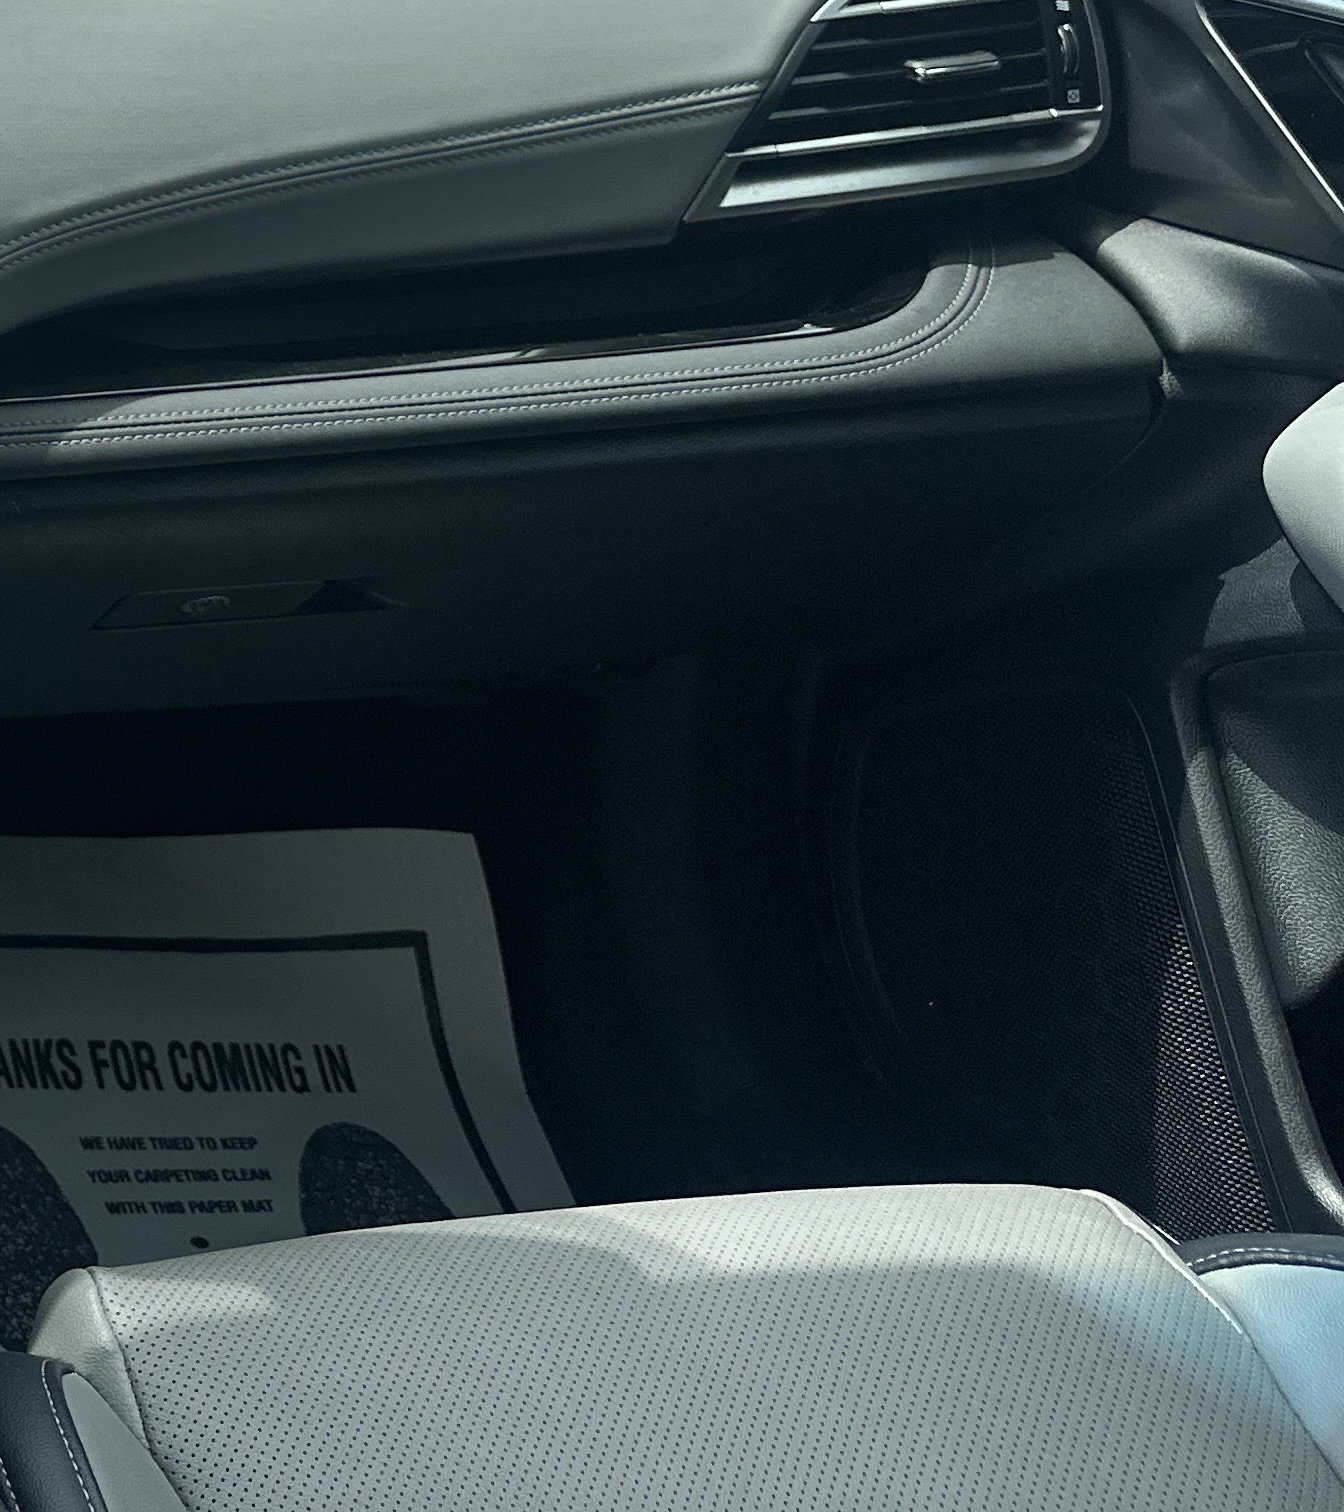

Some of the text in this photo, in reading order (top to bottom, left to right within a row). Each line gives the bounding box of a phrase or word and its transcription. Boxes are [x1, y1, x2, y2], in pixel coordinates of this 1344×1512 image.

[87, 1040, 162, 1091] FOR
[167, 1041, 311, 1093] COMING
[312, 1043, 357, 1093] IN
[79, 1136, 258, 1151] WE HAVE TRIED TO KEEP
[86, 1168, 272, 1184] YOUR CARPETING CLEAN
[105, 1199, 274, 1214] WITH THIS PAPER MAT
